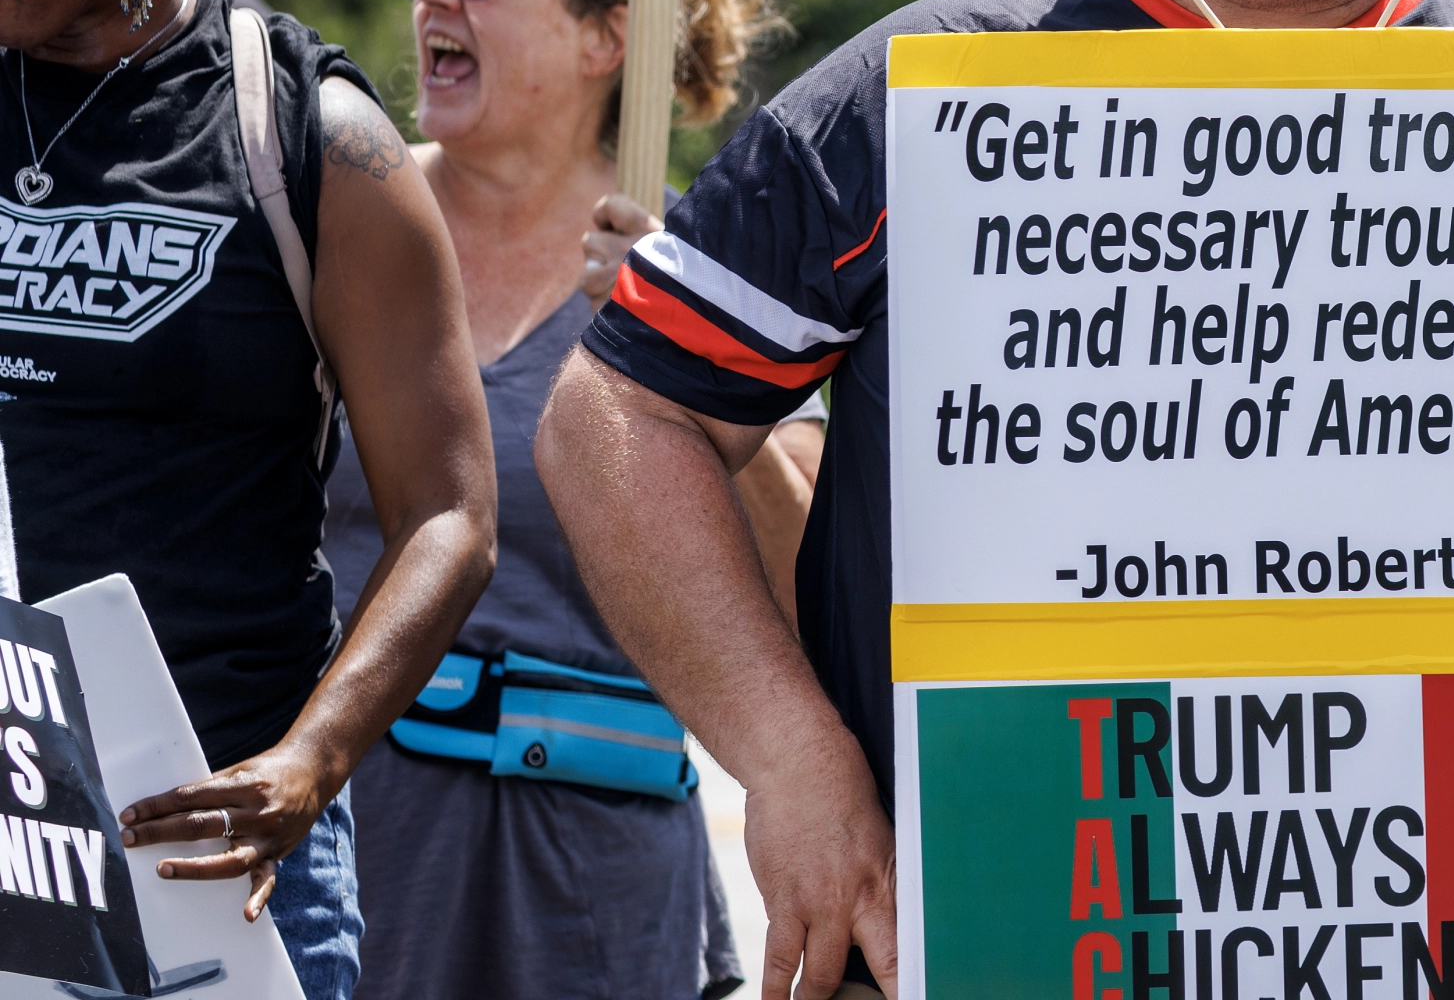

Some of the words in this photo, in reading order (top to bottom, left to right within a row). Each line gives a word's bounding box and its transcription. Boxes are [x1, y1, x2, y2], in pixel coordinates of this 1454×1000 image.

[934, 101, 1080, 183] "Get
[1099, 97, 1158, 178] in
[1182, 92, 1346, 198] good
[973, 209, 1310, 290] necessary
[1003, 285, 1128, 371] and
[1148, 282, 1290, 385] help
[936, 383, 1042, 466] the
[1063, 378, 1203, 464] soul
[1224, 376, 1295, 460] of
[1055, 540, 1229, 599] -John
[0, 638, 69, 728] UT
[1067, 692, 1368, 799] TRUMP
[1069, 805, 1427, 921] ALWAYS
